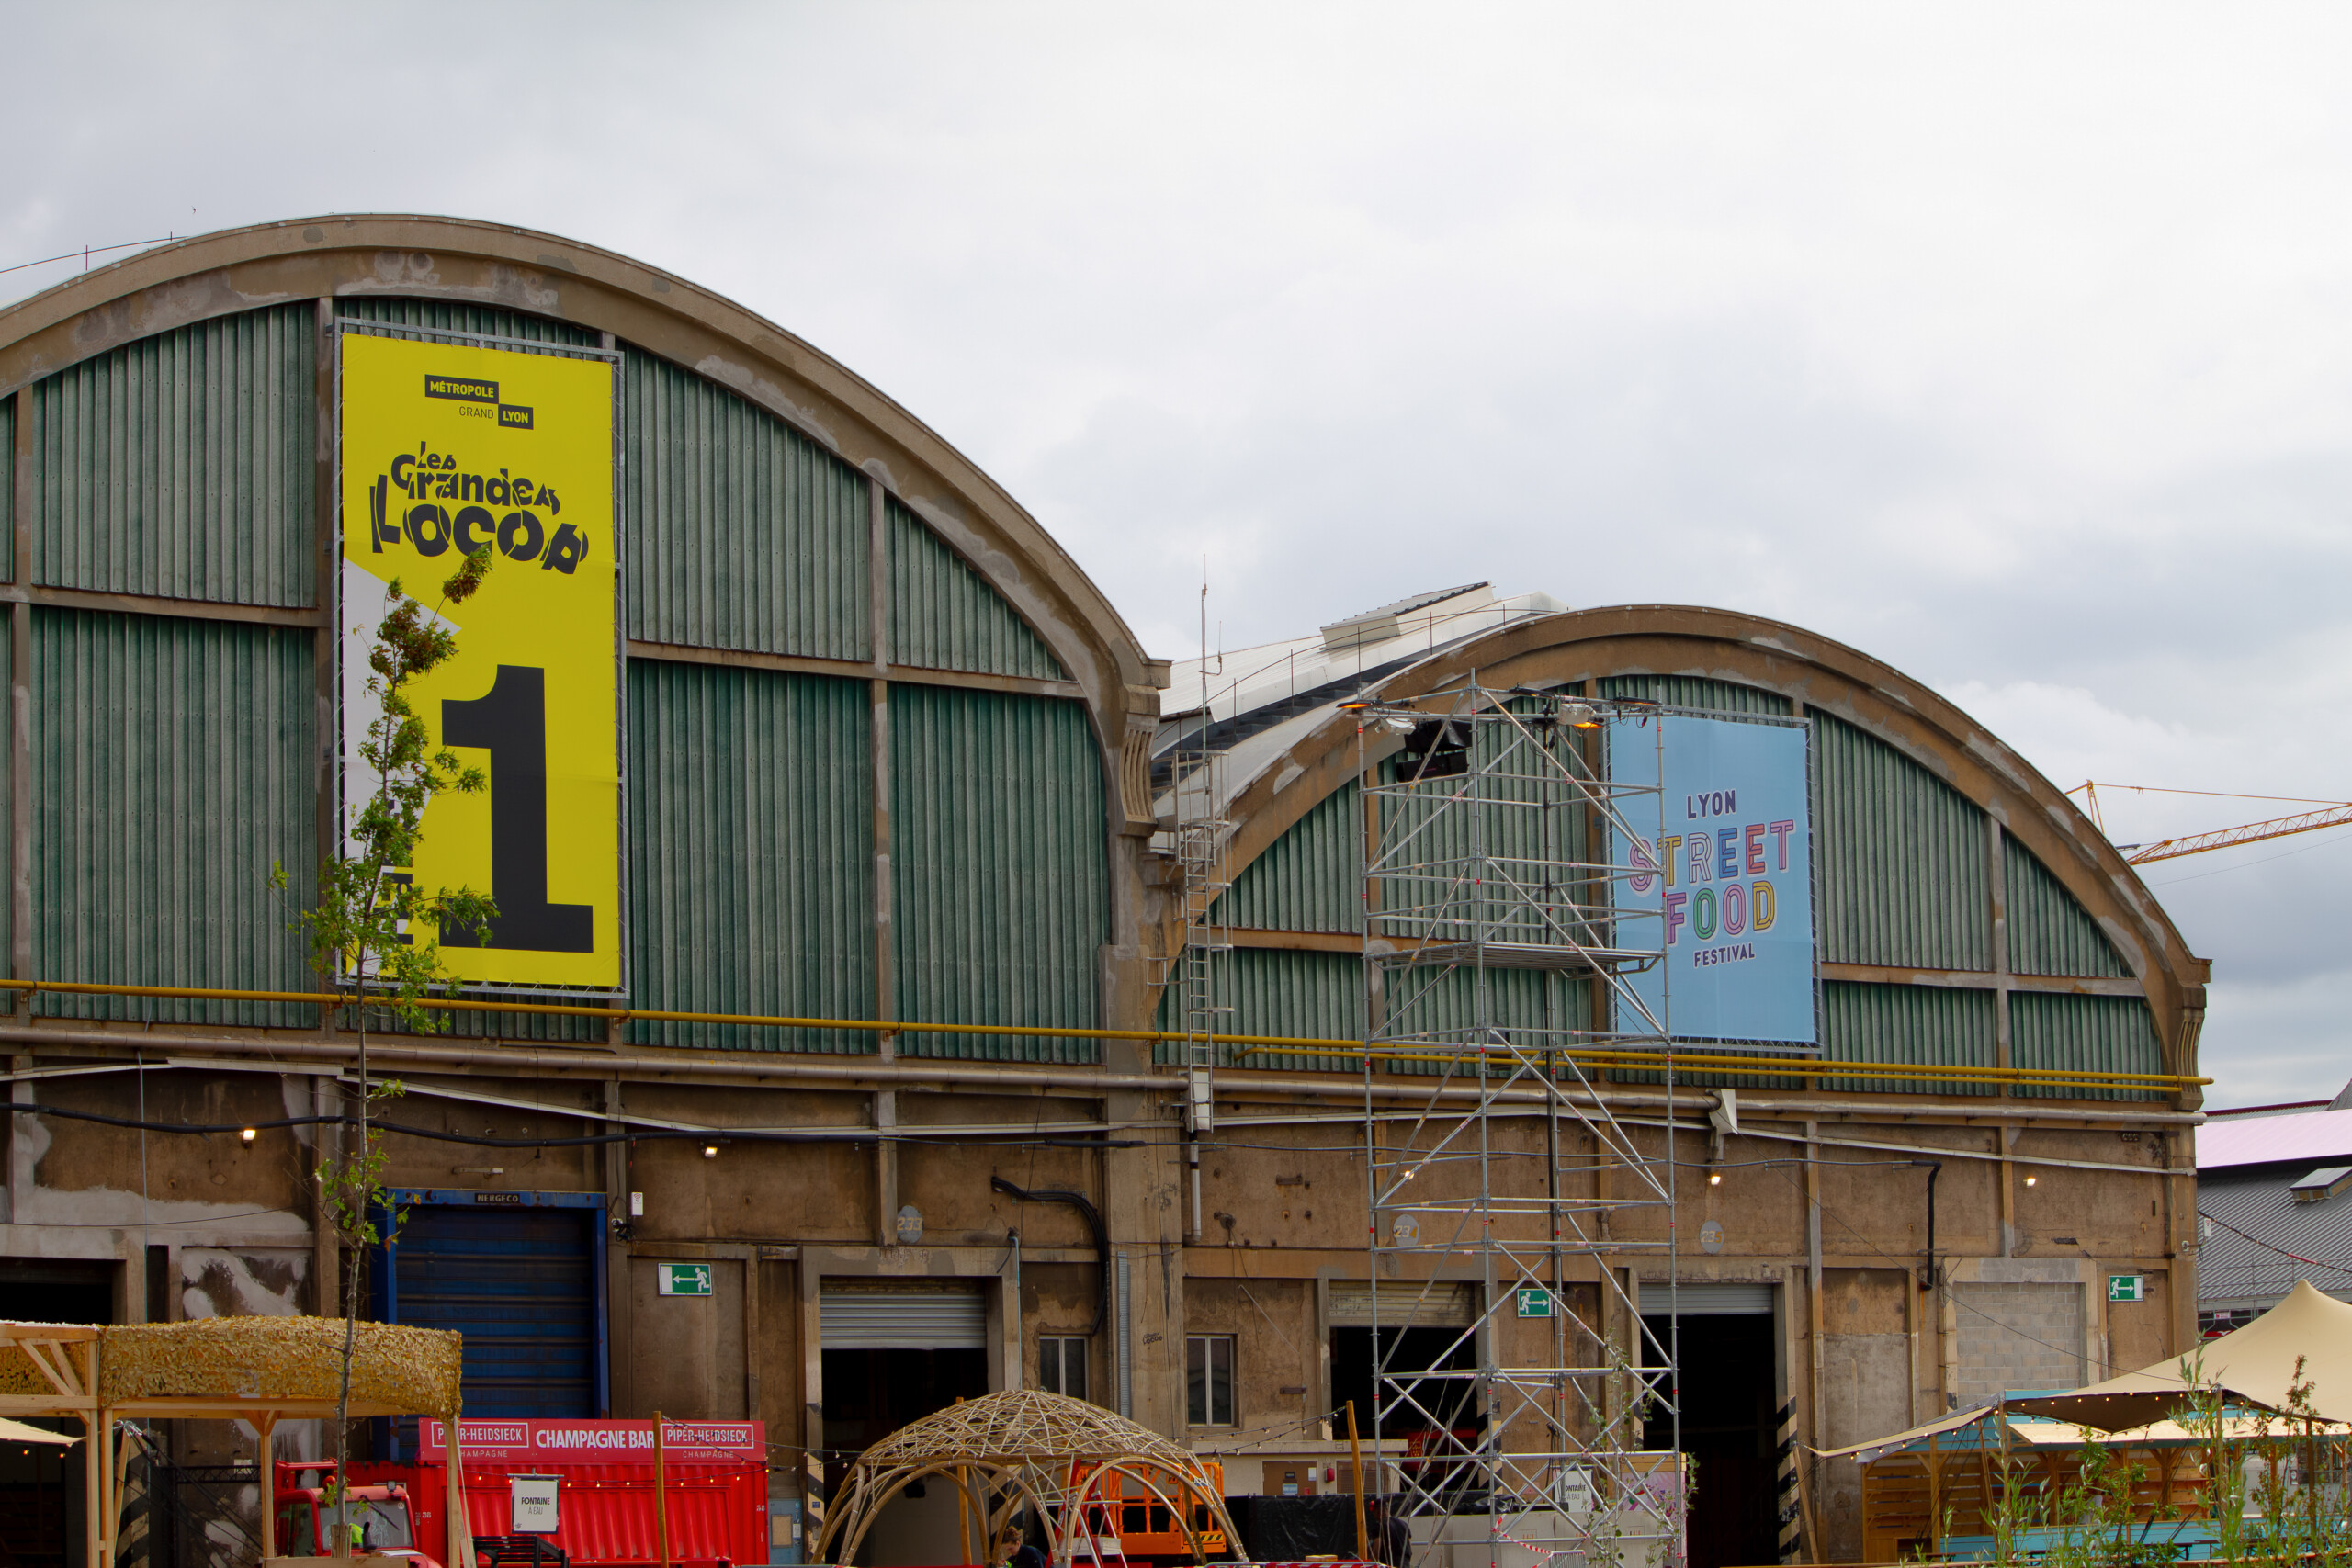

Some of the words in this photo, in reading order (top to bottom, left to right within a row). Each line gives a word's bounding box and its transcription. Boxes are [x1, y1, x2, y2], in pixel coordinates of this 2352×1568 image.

[430, 380, 494, 398] MÉTROPOLE
[458, 406, 494, 419] GRAND
[503, 410, 529, 423] LYON
[417, 441, 457, 470] Les
[390, 454, 560, 516] Grandes
[439, 664, 594, 953] 1
[1686, 789, 1736, 819] LYON
[1628, 819, 1794, 893] STREET
[1667, 880, 1777, 945] FOOD
[1693, 942, 1755, 968] FESTIVAL
[477, 1194, 519, 1202] NERGECO
[897, 1216, 922, 1231] 233
[1701, 1230, 1723, 1243] 235
[437, 1427, 522, 1441] PR-HEIDSIECK
[535, 1429, 626, 1449] CHAMPAGNE
[628, 1430, 654, 1449] BAR
[667, 1429, 747, 1443] PIPER-HEIDSIECK
[683, 1450, 734, 1459] CHAMPAGNE
[521, 1496, 550, 1505] FONTAINE
[533, 1506, 544, 1515] EAU
